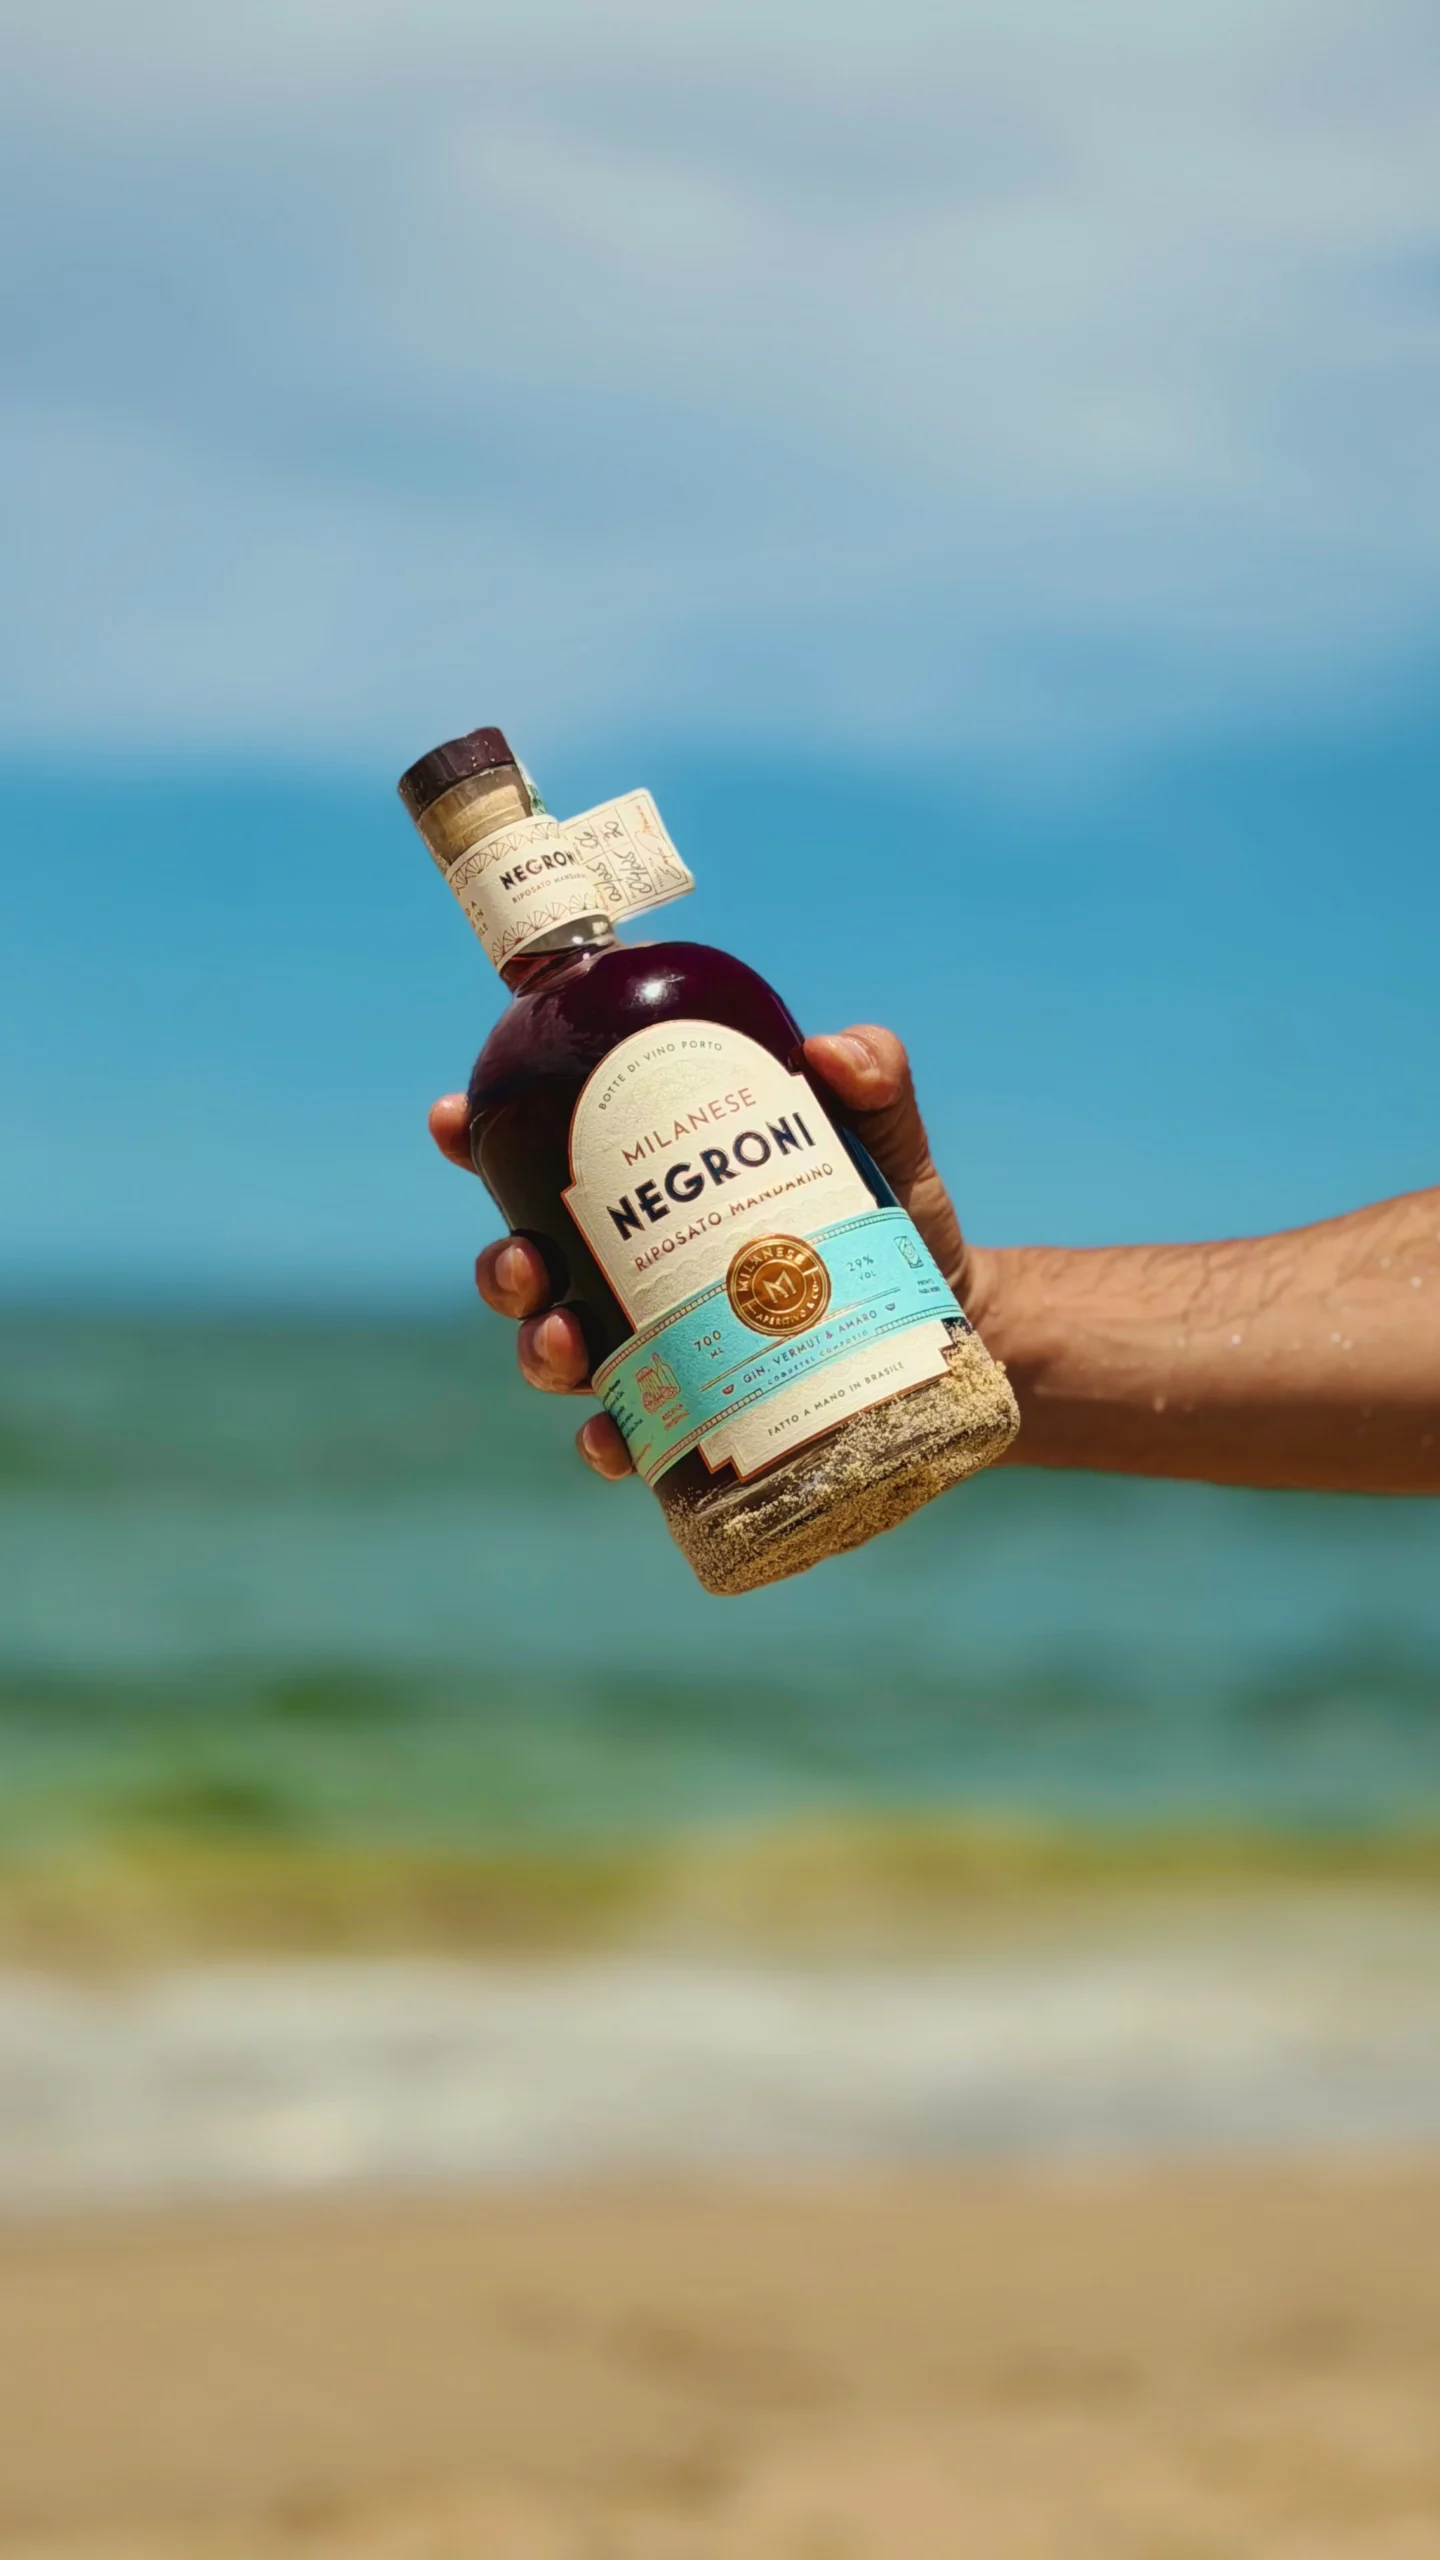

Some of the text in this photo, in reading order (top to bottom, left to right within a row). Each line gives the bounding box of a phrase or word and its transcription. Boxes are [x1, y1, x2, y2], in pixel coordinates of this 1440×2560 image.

[512, 880, 551, 904] RIPOSATO
[598, 1040, 722, 1110] BOTTE DI VINO PORTO
[621, 1087, 757, 1167] MILANESE
[605, 1112, 816, 1241] NEGRONI
[634, 1162, 834, 1272] RIPOSATO MANDARINO
[738, 1247, 806, 1292] MILANESE
[847, 1255, 874, 1272] 29%
[859, 1270, 877, 1281] VOL
[762, 1270, 797, 1303] M
[694, 1330, 721, 1351] 700
[710, 1347, 724, 1359] ML
[743, 1310, 877, 1383] GIN, VERMUT & AMARO
[768, 1361, 905, 1436] FATTO A MANO IN BRASILE
